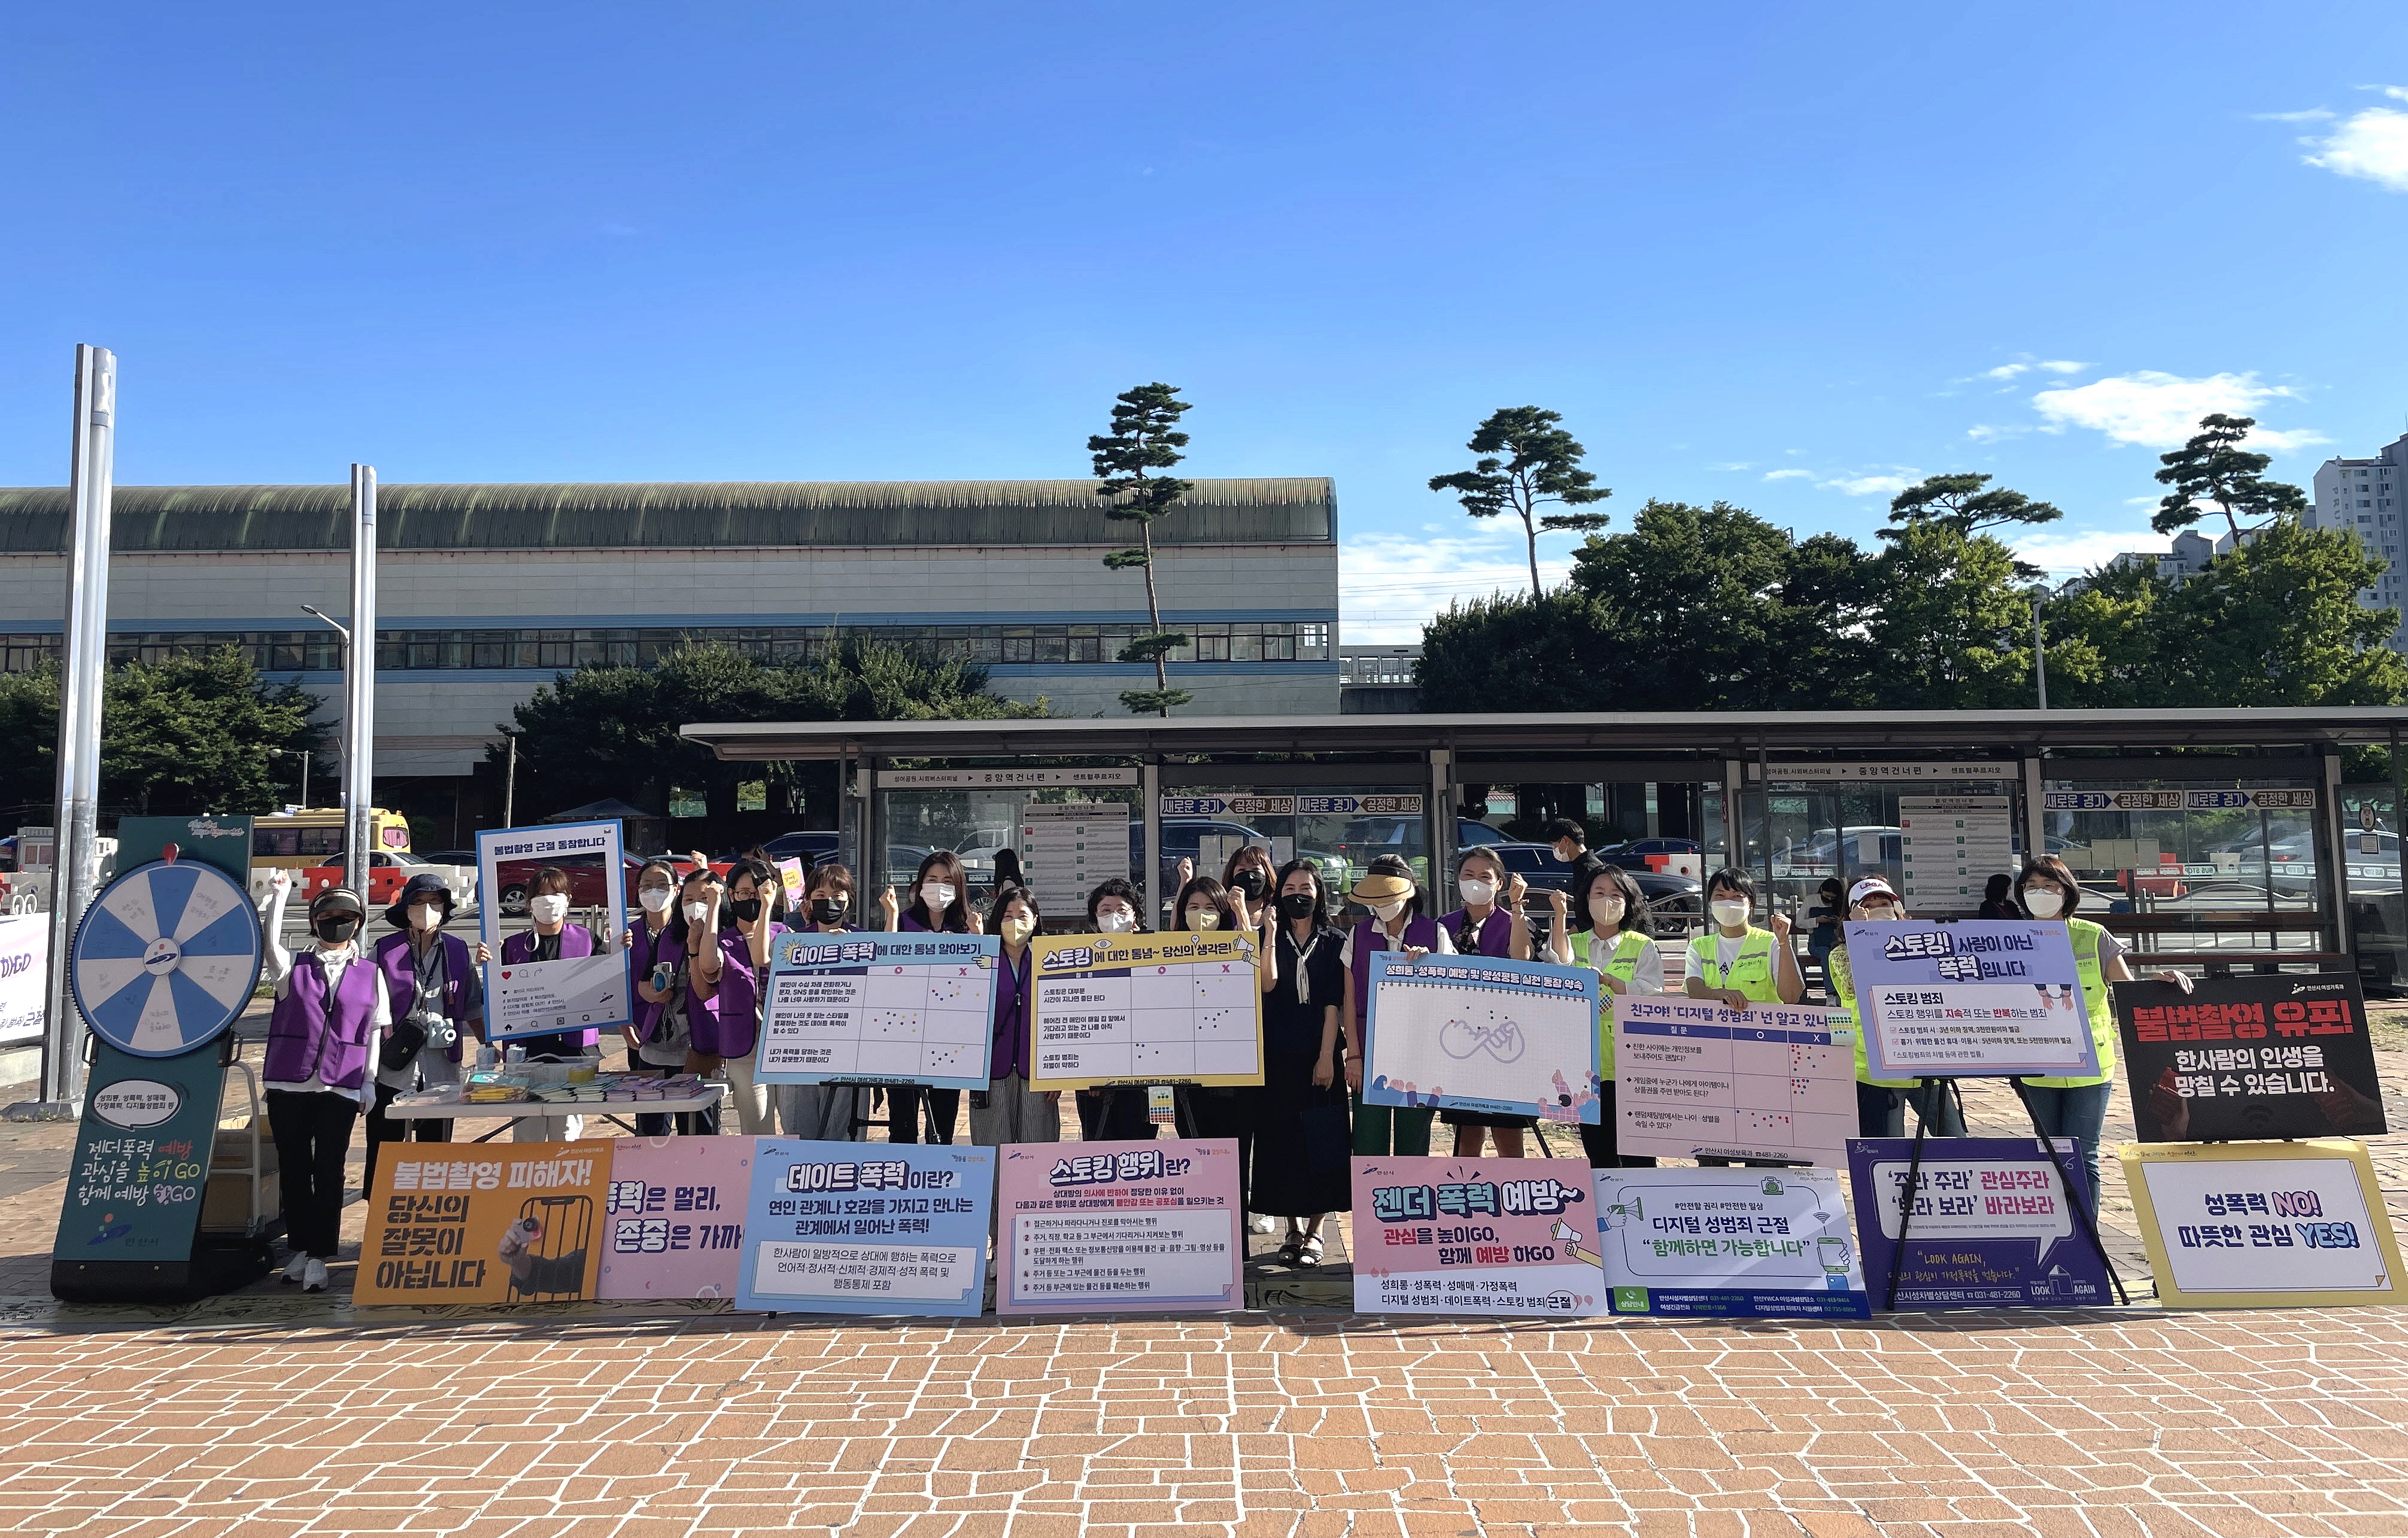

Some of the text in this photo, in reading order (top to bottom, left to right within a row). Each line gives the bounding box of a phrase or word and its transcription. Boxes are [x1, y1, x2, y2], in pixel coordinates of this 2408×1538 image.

[1073, 773, 1122, 781] 센트럴푸르지오
[1163, 797, 1292, 813] 새로운 경기 공정한 세상
[1299, 797, 1420, 813] 새로운 경기 공정한 세상
[2045, 793, 2179, 808] 새로운 경기 공정한 세상
[2188, 792, 2313, 807] 새로운 경기 공정한 세상
[494, 837, 605, 855] 불법촬영 근절 동참합니다
[791, 943, 981, 966] 데이트 대한 통념 알아보기
[1107, 943, 1232, 962] 대한 당신의 생각은!
[1884, 932, 2034, 961] 스토킹! 사랑이 아닌
[1449, 968, 1584, 991] 예방 및 약속
[1884, 992, 1944, 1005] 스토킹 범죄
[1630, 1003, 1800, 1027] 친구야! 넌 알고
[1887, 1008, 2047, 1019] 스토킹 행위를 지속적 또는 반복하는 범죄
[2133, 999, 2354, 1042] 불법촬영 유포!
[1647, 1044, 1671, 1052] 사이에는
[1672, 1045, 1702, 1054] 개인정보를
[2174, 1045, 2324, 1072] 한사람의 인생을
[1633, 1077, 1657, 1085] 게임중에
[1678, 1079, 1698, 1087] 나에게
[1698, 1080, 1729, 1090] 아이템이나
[1634, 1086, 1659, 1095] 상품권을
[1660, 1087, 1672, 1096] 주면
[2174, 1071, 2335, 1098] 망칠 수 있습니다.
[89, 1139, 193, 1161] 젠더폭력 예방
[81, 1160, 130, 1183] 관심을
[394, 1159, 593, 1190] 불법촬영 피해자!
[1980, 1171, 2049, 1190] 관심주라
[78, 1185, 149, 1206] 함께 예방
[674, 1186, 720, 1211] 멀리,
[1053, 1189, 1082, 1197] 상대방의
[1131, 1188, 1152, 1196] 정당한
[1153, 1187, 1168, 1196] 이유
[387, 1195, 470, 1223] 당신의
[769, 1197, 973, 1216] 연인 관계나 호감을 가지고 만나는
[1015, 1196, 1224, 1209] 다음과 같은 행위로 상대방에게 또는 공포심을 일으키는 것
[1373, 1182, 1501, 1222] 젠더 폭력
[1720, 1202, 1747, 1211] #안전한
[1749, 1202, 1763, 1211] 일상
[1985, 1196, 2055, 1215] 바라보라
[2204, 1190, 2323, 1218] 성폭력 NO!
[614, 1218, 691, 1253] 존중은
[795, 1218, 930, 1235] 관계에서 일어난 폭력!
[1384, 1226, 1499, 1245] 관심을 높이GO,
[1652, 1217, 1791, 1235] 디지털 성범죄 근절
[2178, 1222, 2361, 1249] 따뜻한 관심 YES!
[381, 1227, 464, 1256] 잘못이
[773, 1248, 957, 1264] 한사람이 일방적으로 상대에 행하는 폭력으로
[1438, 1245, 1554, 1265] 함께 예방 하GO
[1952, 1253, 1987, 1268] AGAIN,
[376, 1259, 486, 1288] 아닙니다
[1133, 1268, 1146, 1276] 행위
[1915, 1271, 1938, 1281] 관심이
[1941, 1270, 1979, 1283] 가정폭력을
[833, 1279, 892, 1291] 행동통제 포함
[2030, 1285, 2096, 1295] LOOK AGAIN
[1894, 1291, 1965, 1301] 산시성차별상담센터
